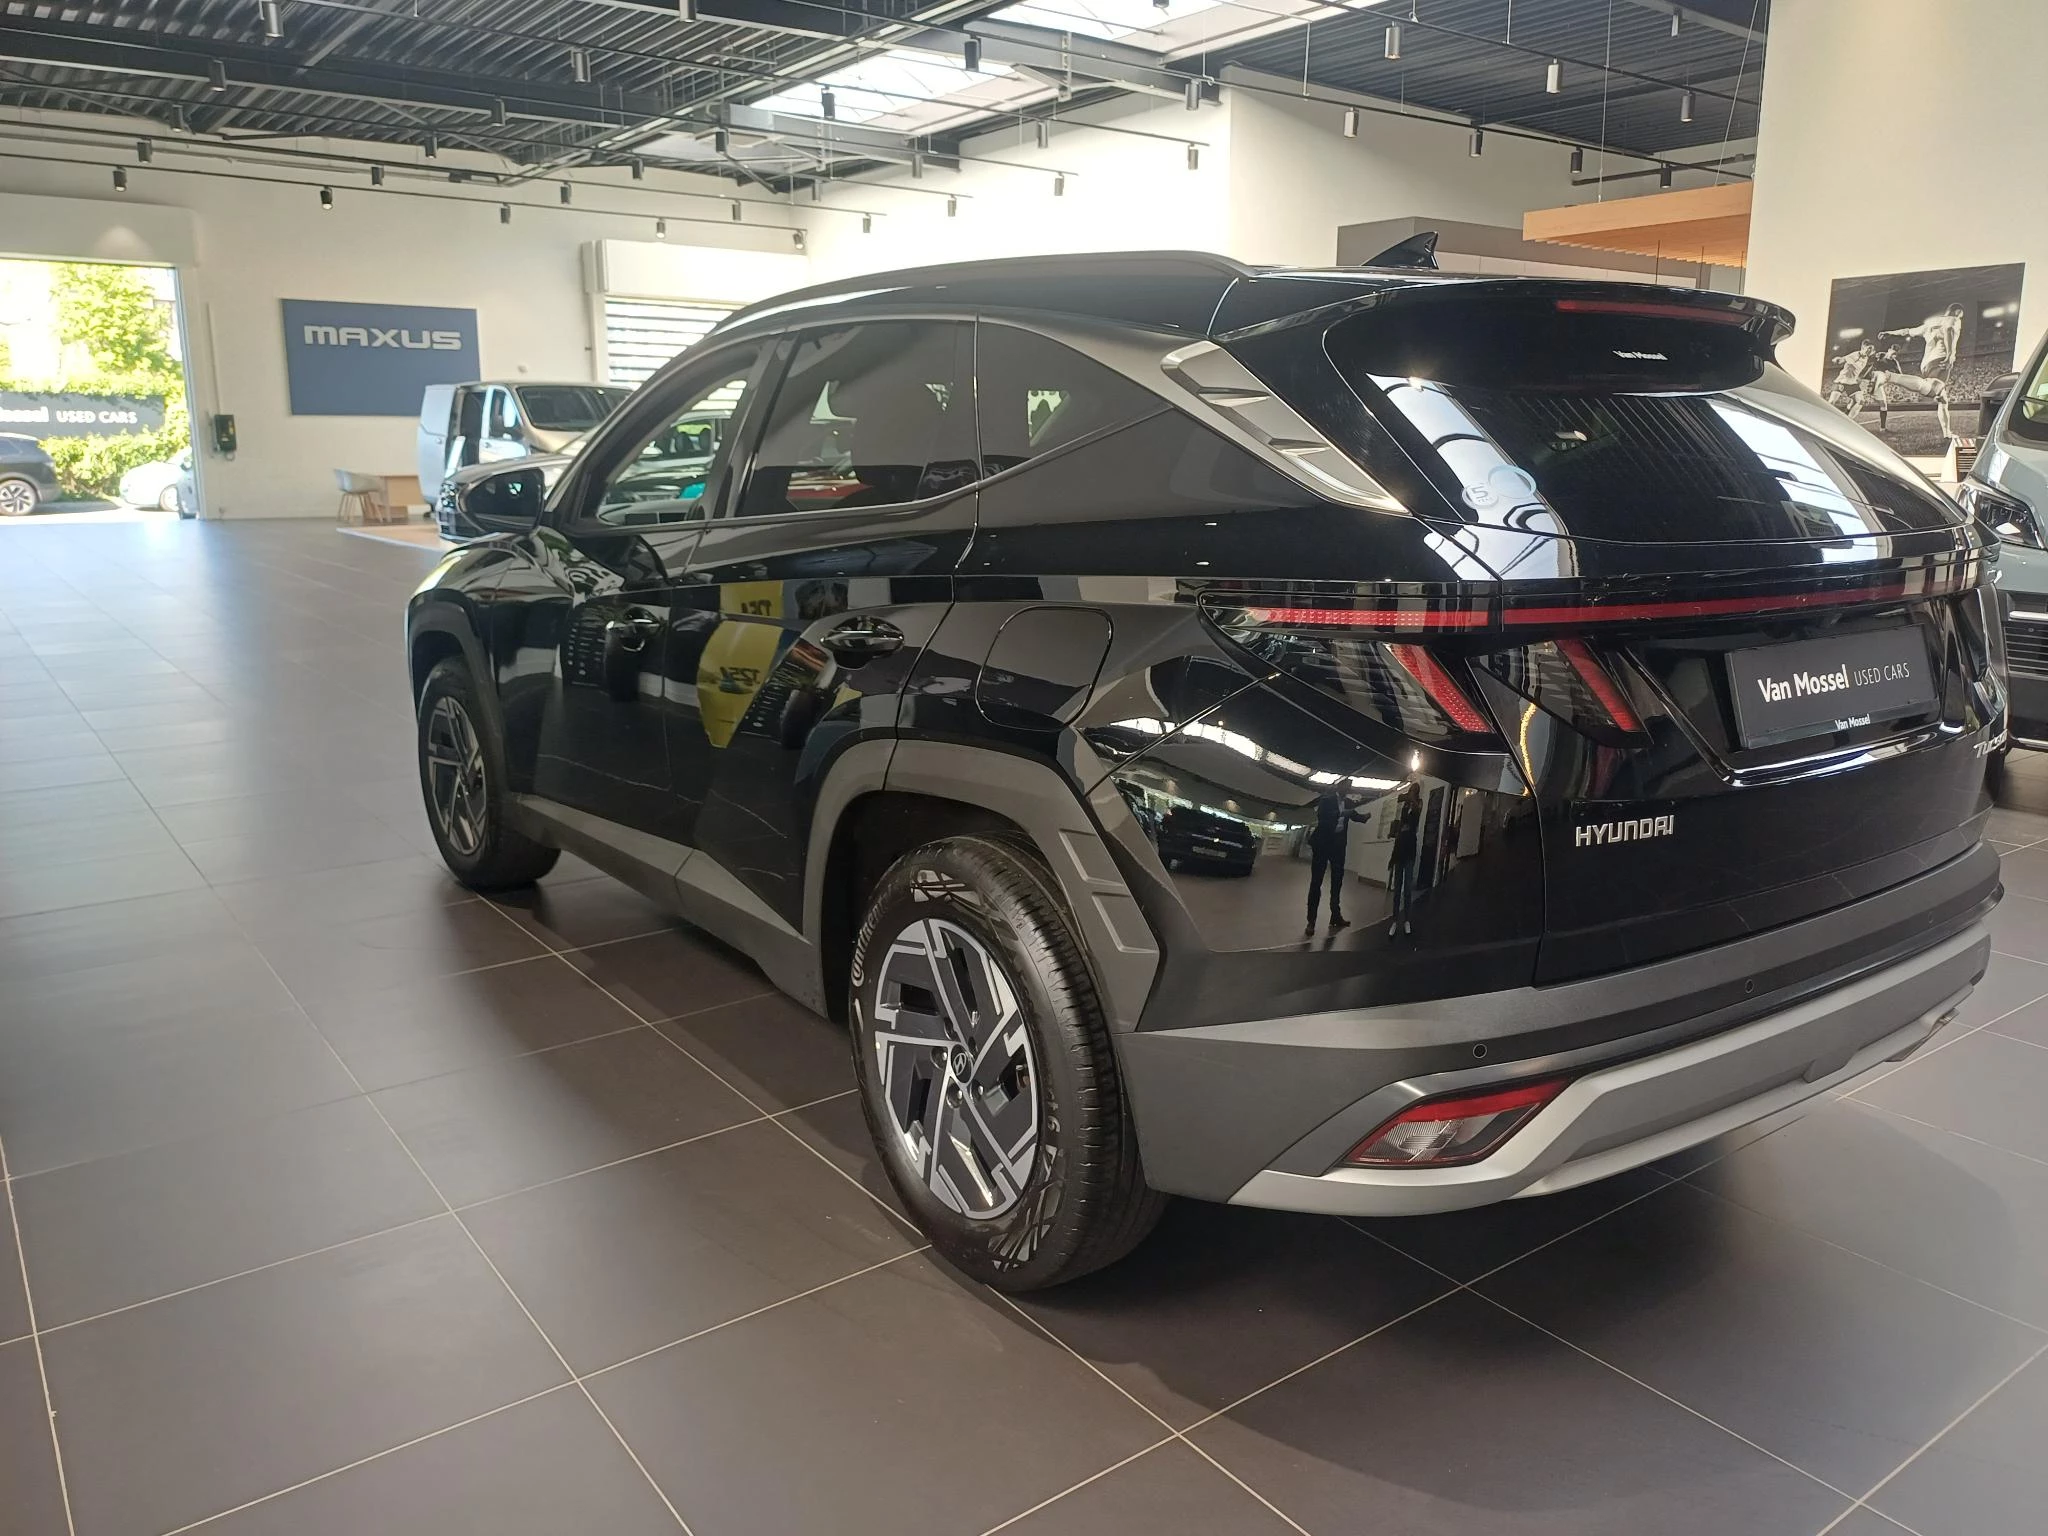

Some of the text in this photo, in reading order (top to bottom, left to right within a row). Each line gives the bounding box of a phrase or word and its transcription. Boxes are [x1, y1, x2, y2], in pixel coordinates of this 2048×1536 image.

[303, 325, 462, 350] MAXUS
[56, 410, 96, 424] USED
[98, 411, 138, 424] CARS
[1757, 662, 1910, 703] Van Mossel USED CARS
[1834, 713, 1871, 730] Van Mossel
[1575, 814, 1675, 847] HYUNDAI
